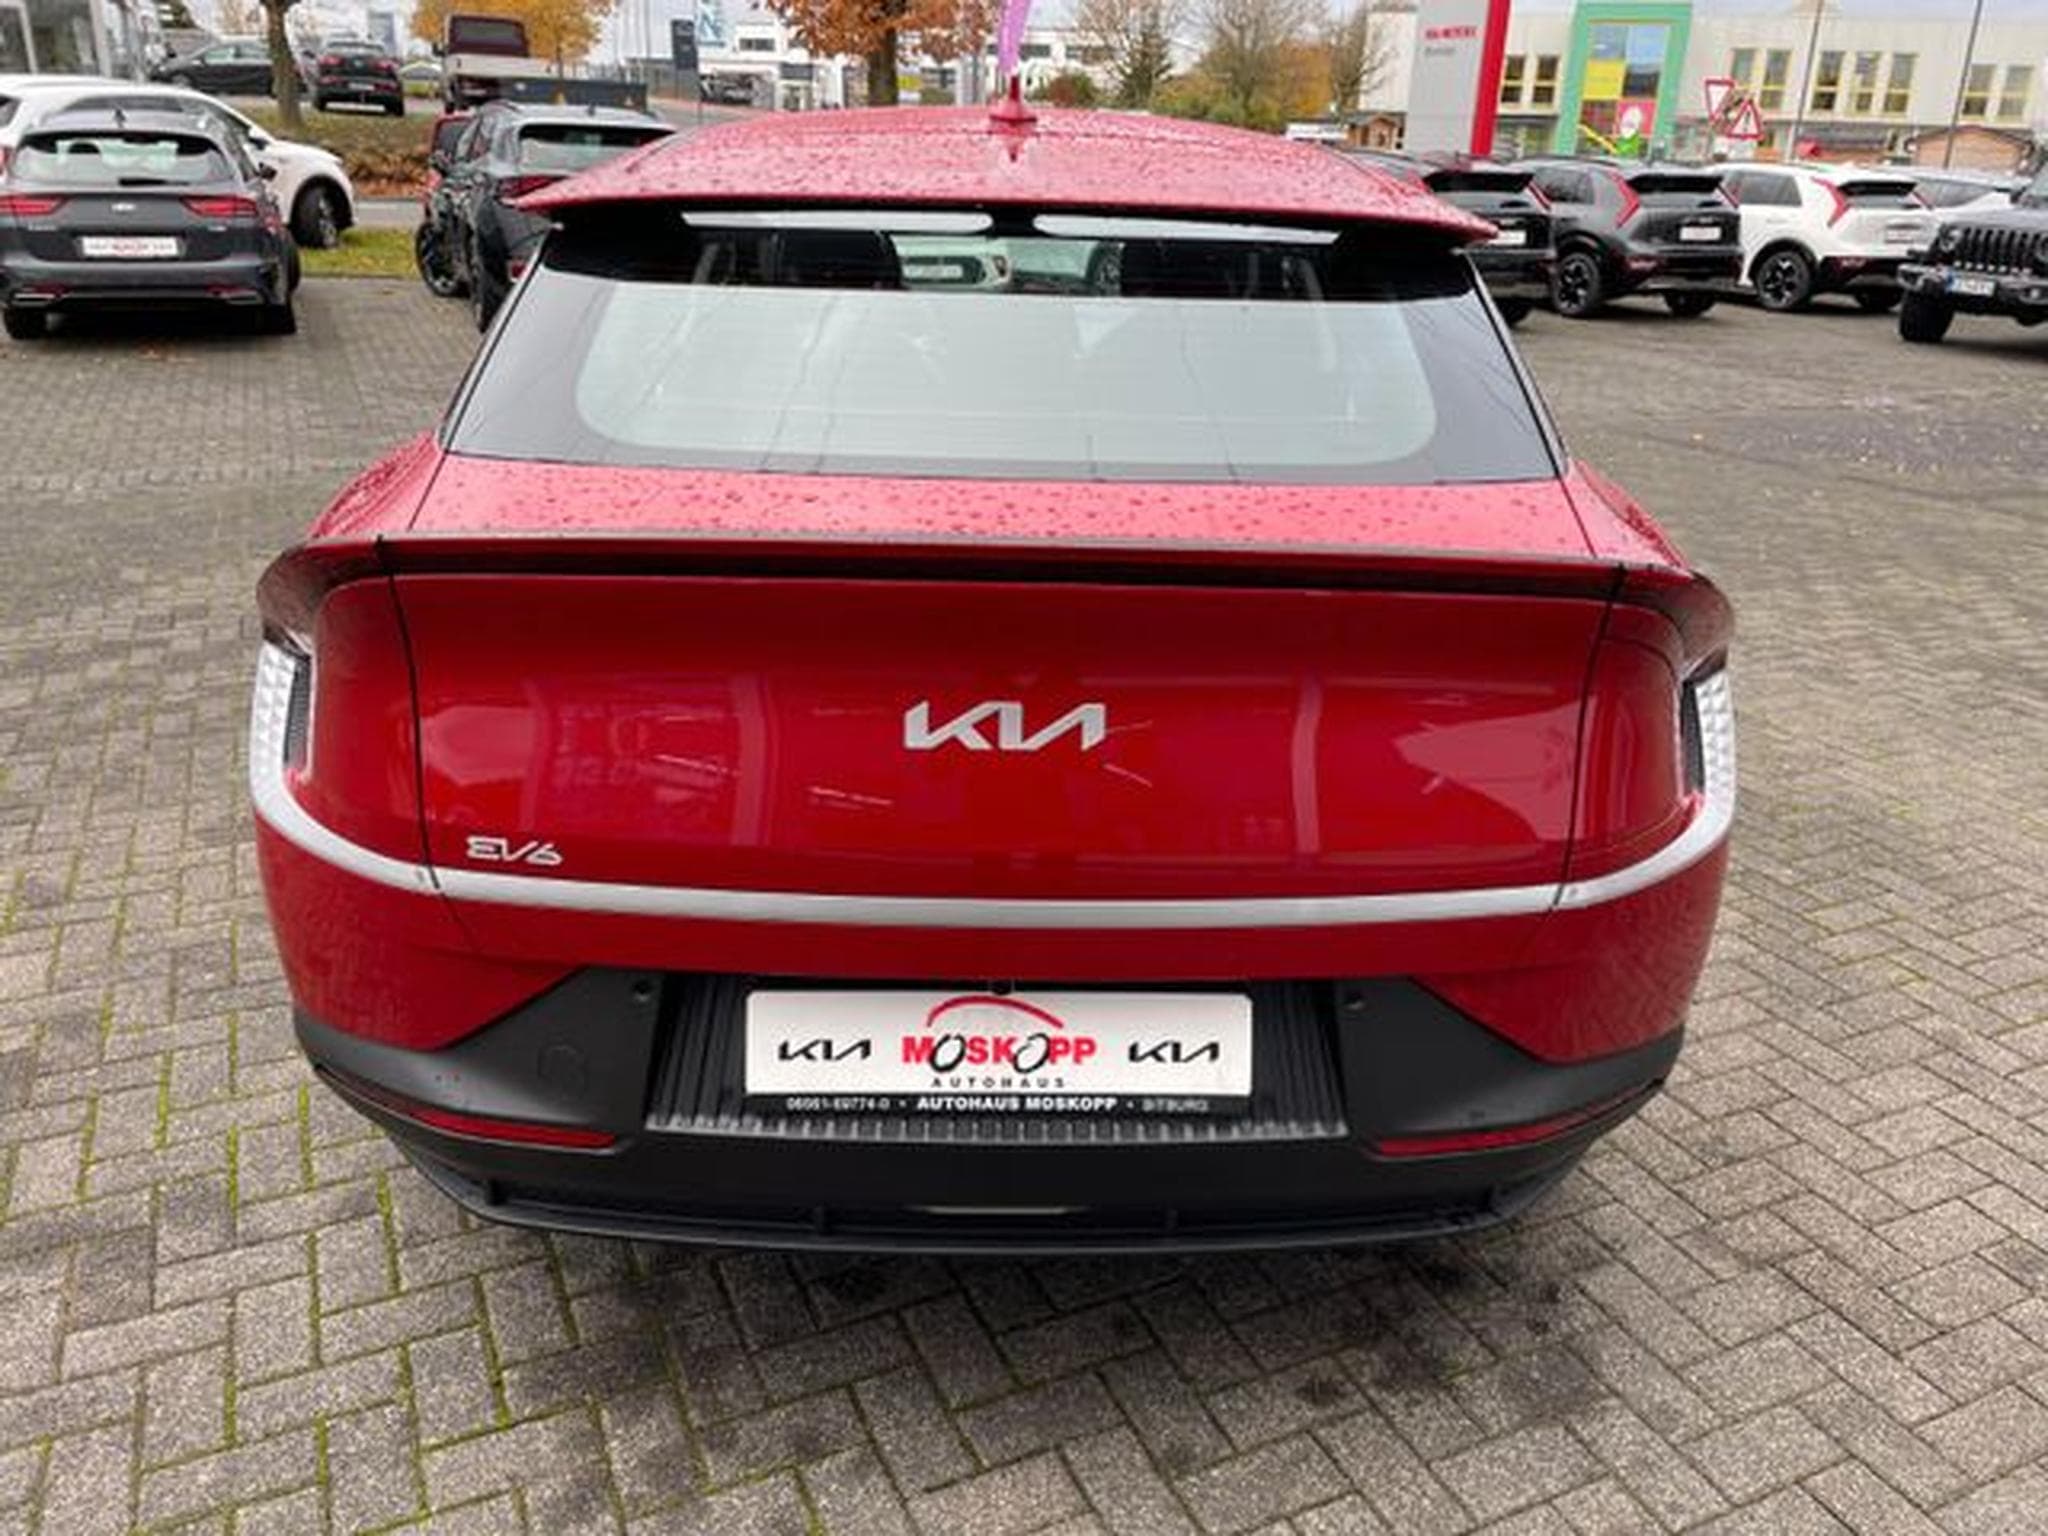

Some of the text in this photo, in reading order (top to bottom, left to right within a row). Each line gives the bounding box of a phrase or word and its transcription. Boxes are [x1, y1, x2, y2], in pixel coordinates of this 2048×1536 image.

[904, 699, 1106, 751] KIA
[466, 836, 562, 865] EV6
[778, 1039, 871, 1061] KIA
[902, 1034, 1096, 1074] MOSKOPP
[1129, 1041, 1219, 1063] KIA
[931, 1077, 1064, 1088] AUTOHAUS
[917, 1097, 1020, 1111] AUTOHAUS
[1025, 1097, 1118, 1111] MOSKOPP
